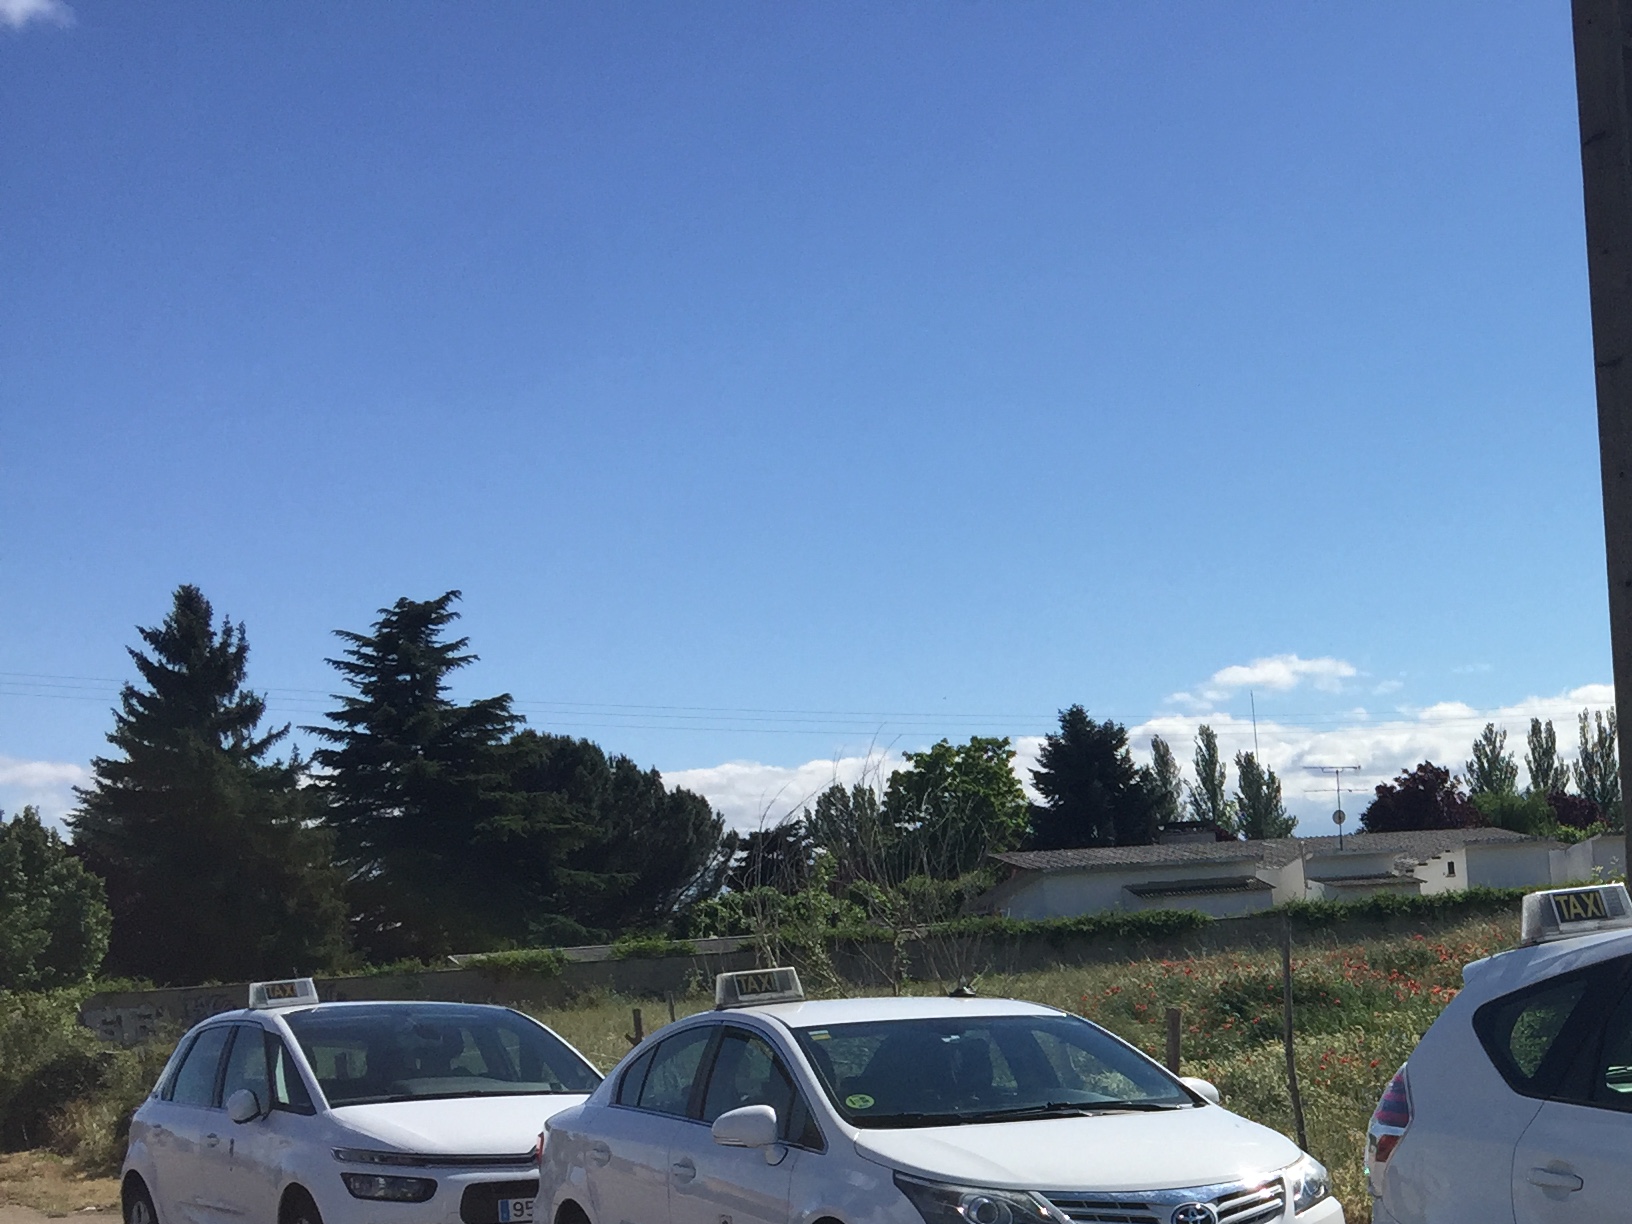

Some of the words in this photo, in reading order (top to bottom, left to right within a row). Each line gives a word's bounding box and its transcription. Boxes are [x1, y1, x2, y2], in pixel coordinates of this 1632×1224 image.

[1554, 892, 1605, 920] TAXI
[265, 983, 297, 999] TAXI
[737, 973, 777, 993] TAXI
